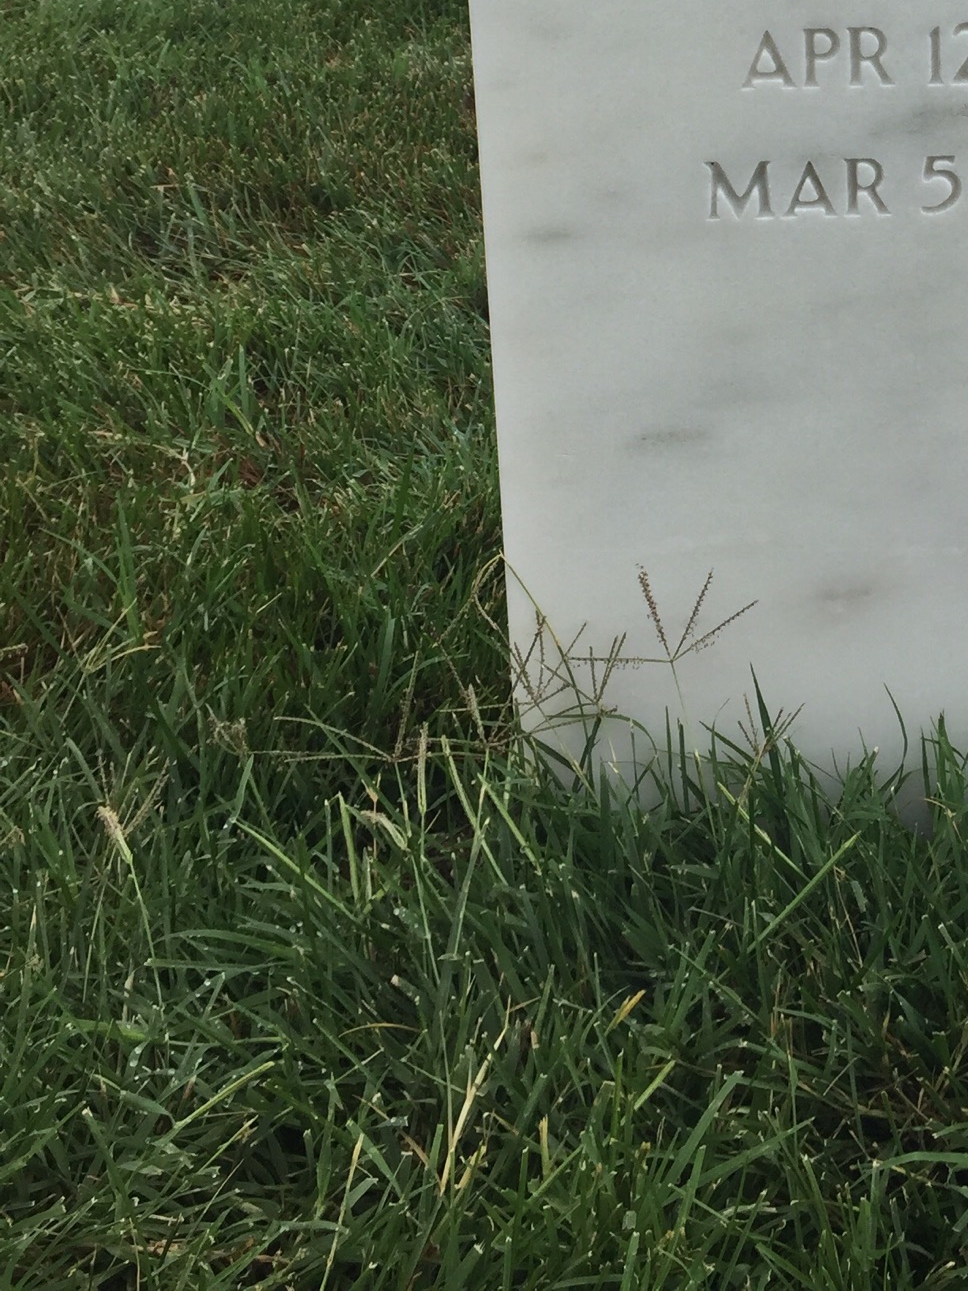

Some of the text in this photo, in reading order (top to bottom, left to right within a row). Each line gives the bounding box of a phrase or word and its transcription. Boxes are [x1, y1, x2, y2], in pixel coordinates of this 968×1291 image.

[741, 25, 896, 90] APR
[703, 156, 892, 220] MAR
[921, 154, 963, 215] 5
